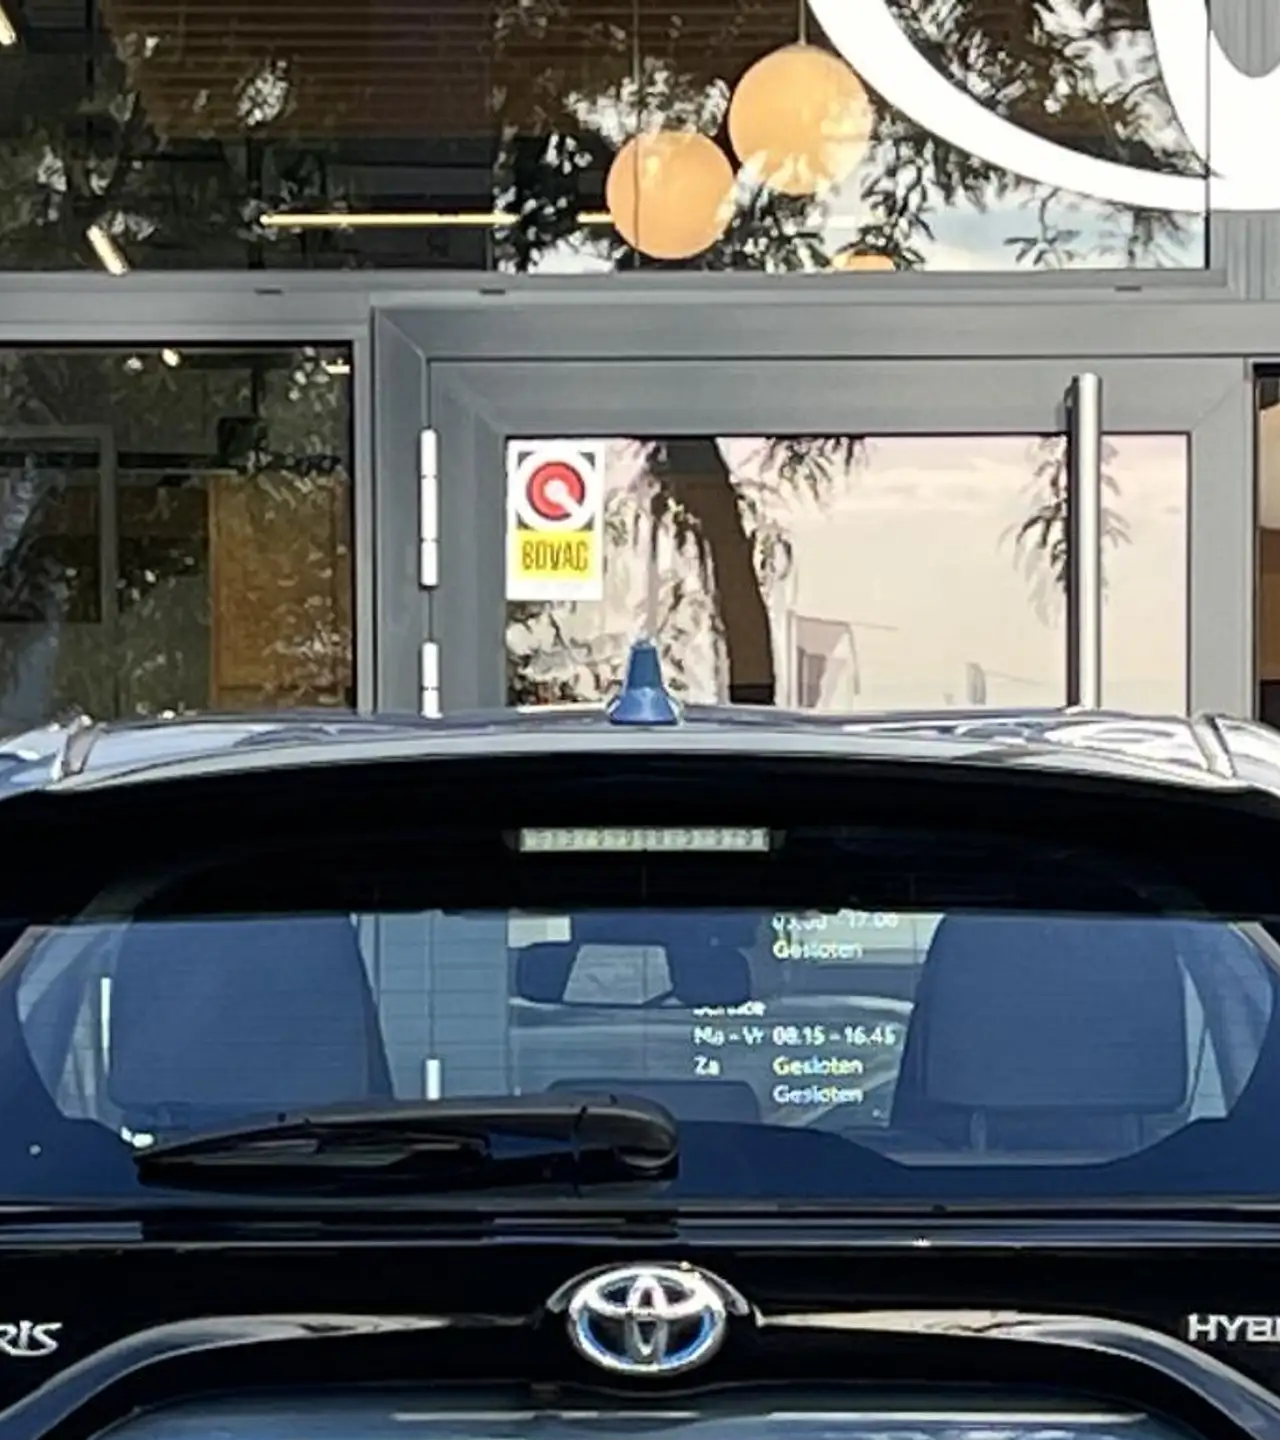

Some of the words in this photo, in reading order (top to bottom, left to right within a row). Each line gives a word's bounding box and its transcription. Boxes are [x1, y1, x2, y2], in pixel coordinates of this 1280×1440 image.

[522, 540, 588, 572] BOVAG
[693, 1055, 720, 1075] Za
[773, 1056, 864, 1075] Gesloten
[773, 1084, 864, 1103] Gesloten
